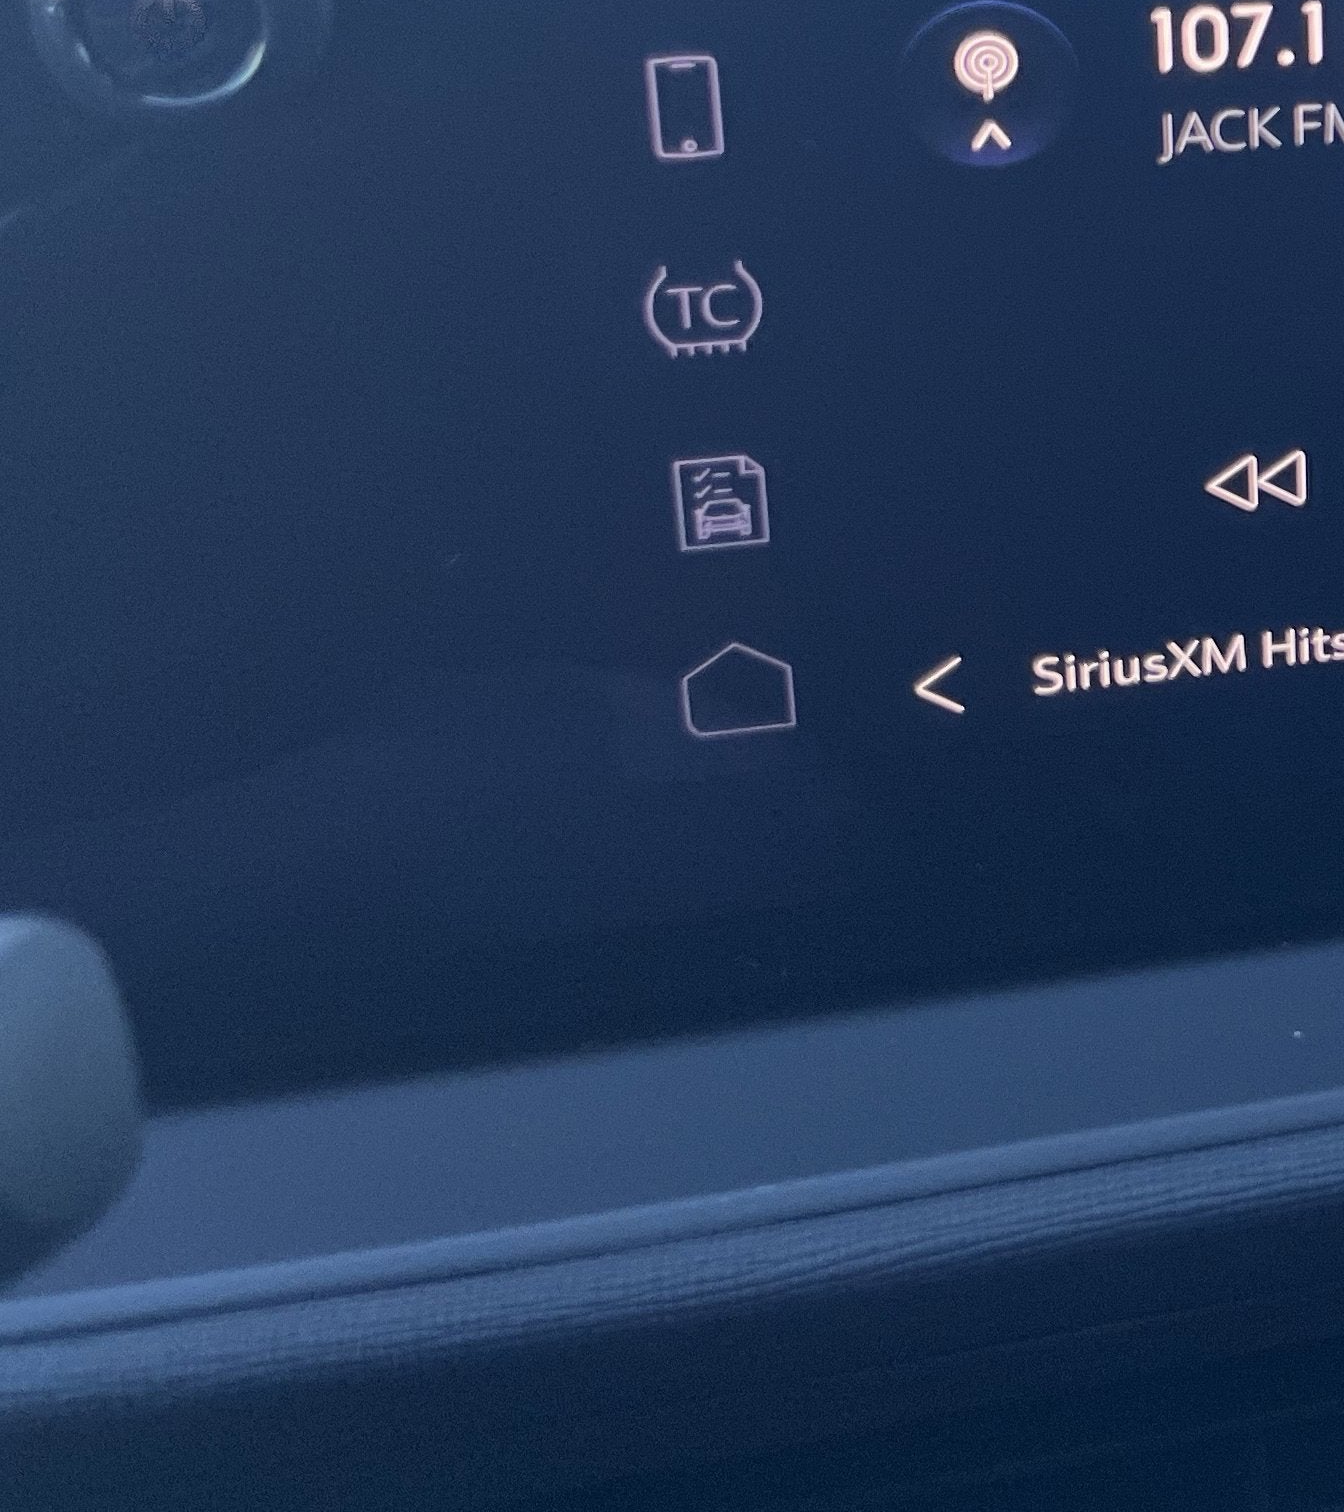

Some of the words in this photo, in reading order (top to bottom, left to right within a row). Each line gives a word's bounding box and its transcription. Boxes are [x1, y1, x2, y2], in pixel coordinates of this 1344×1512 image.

[1155, 103, 1283, 166] JACK
[663, 283, 741, 331] TC
[1031, 630, 1251, 698] SiriusXM
